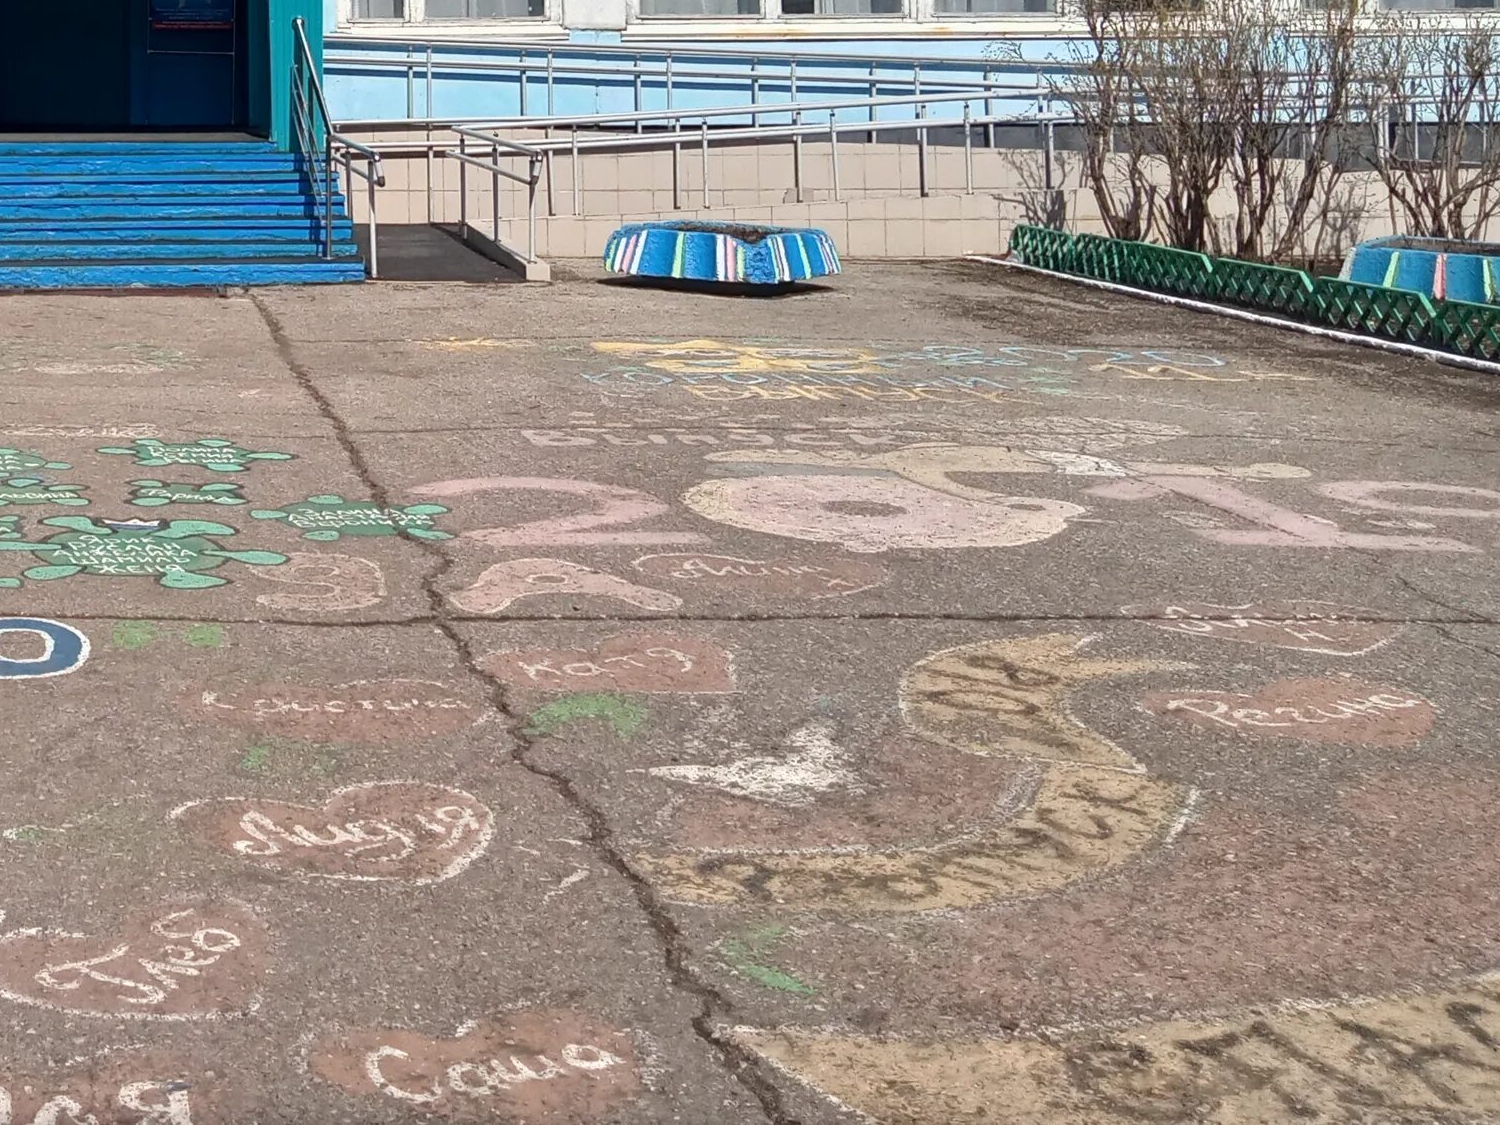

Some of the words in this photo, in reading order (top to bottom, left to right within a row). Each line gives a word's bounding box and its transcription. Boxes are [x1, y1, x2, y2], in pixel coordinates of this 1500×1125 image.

[78, 534, 157, 544] ЯРИК
[67, 540, 182, 551] РУСЛАН
[52, 549, 198, 557] АНЖЕЛИКА
[68, 556, 191, 565] ШАМИЛЬ
[92, 564, 186, 574] ЖЕНЯ
[1166, 693, 1422, 727] Регина
[365, 1044, 627, 1104] Саша
